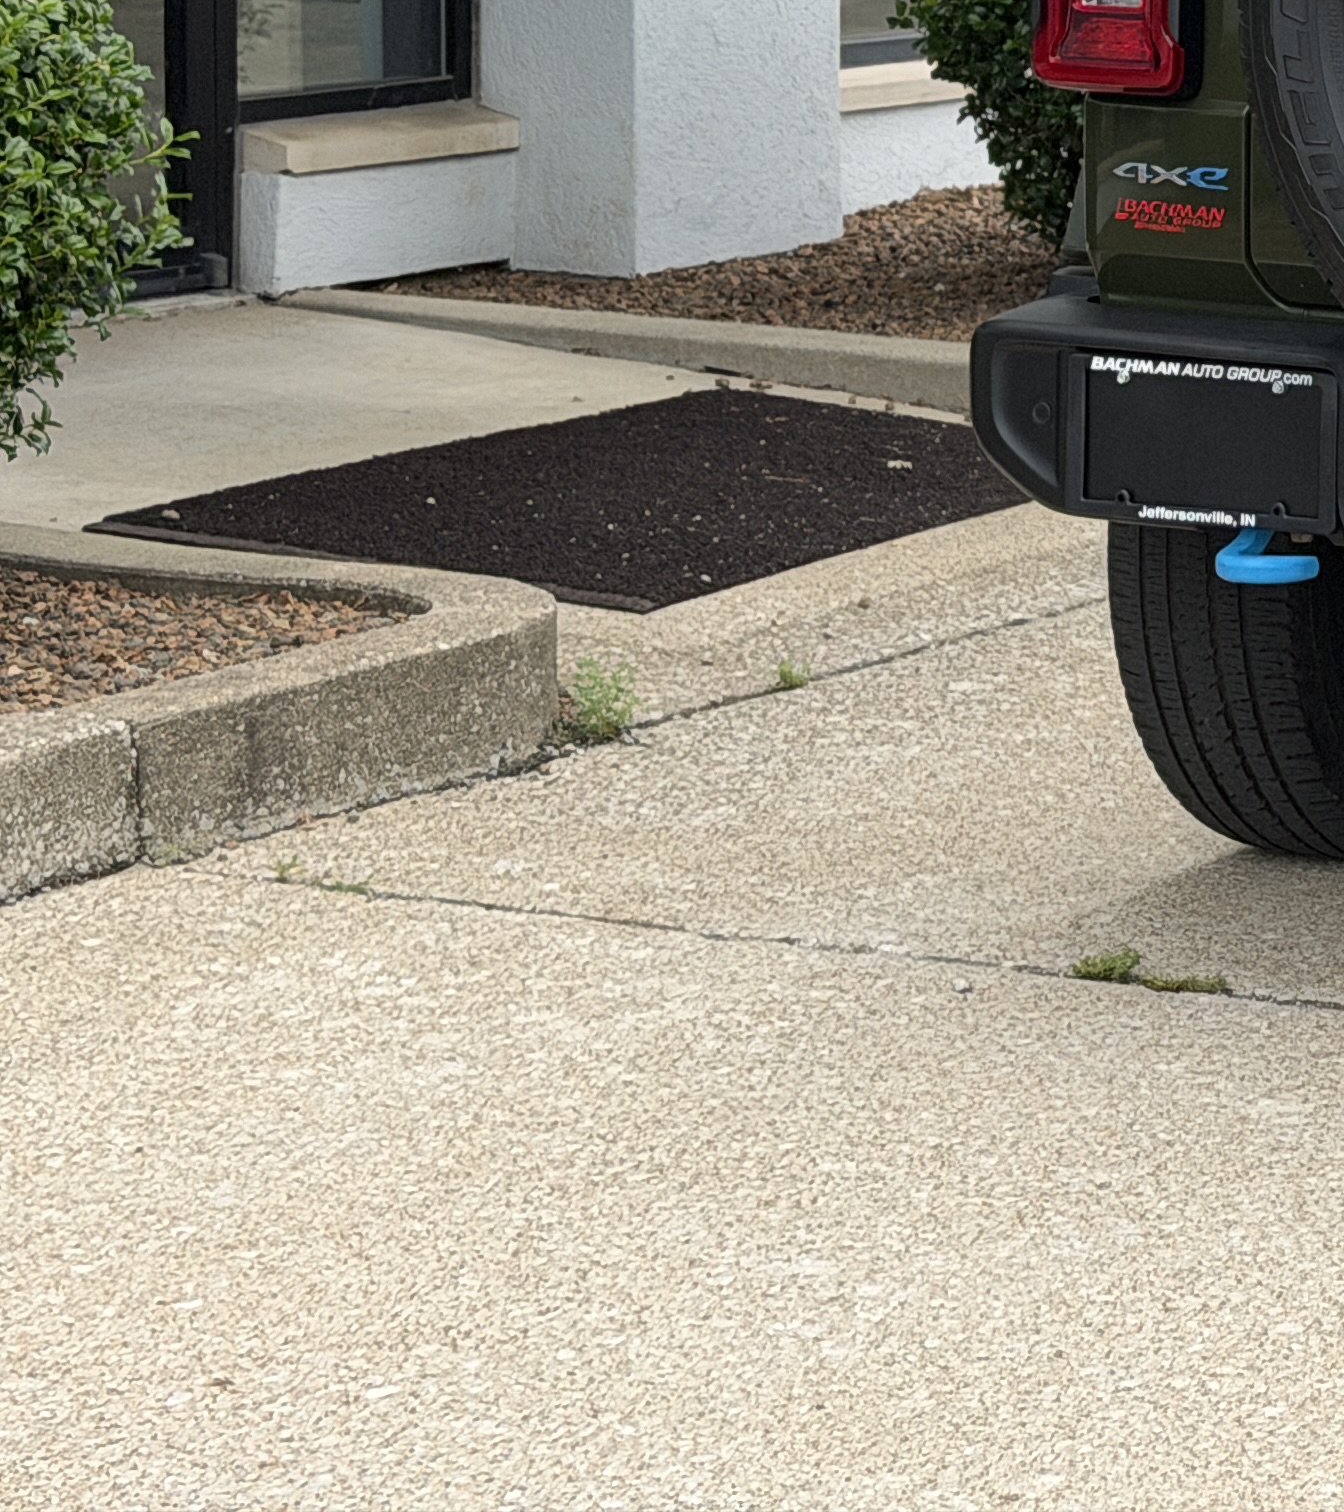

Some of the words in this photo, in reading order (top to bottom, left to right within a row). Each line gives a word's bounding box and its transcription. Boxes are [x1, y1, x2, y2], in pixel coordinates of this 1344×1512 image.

[1124, 198, 1226, 221] BACHMAN
[1090, 355, 1181, 377] BACHMAN
[1181, 363, 1224, 379] AUTO
[1138, 504, 1238, 528] Jeffersonville,
[1240, 512, 1256, 527] IN
